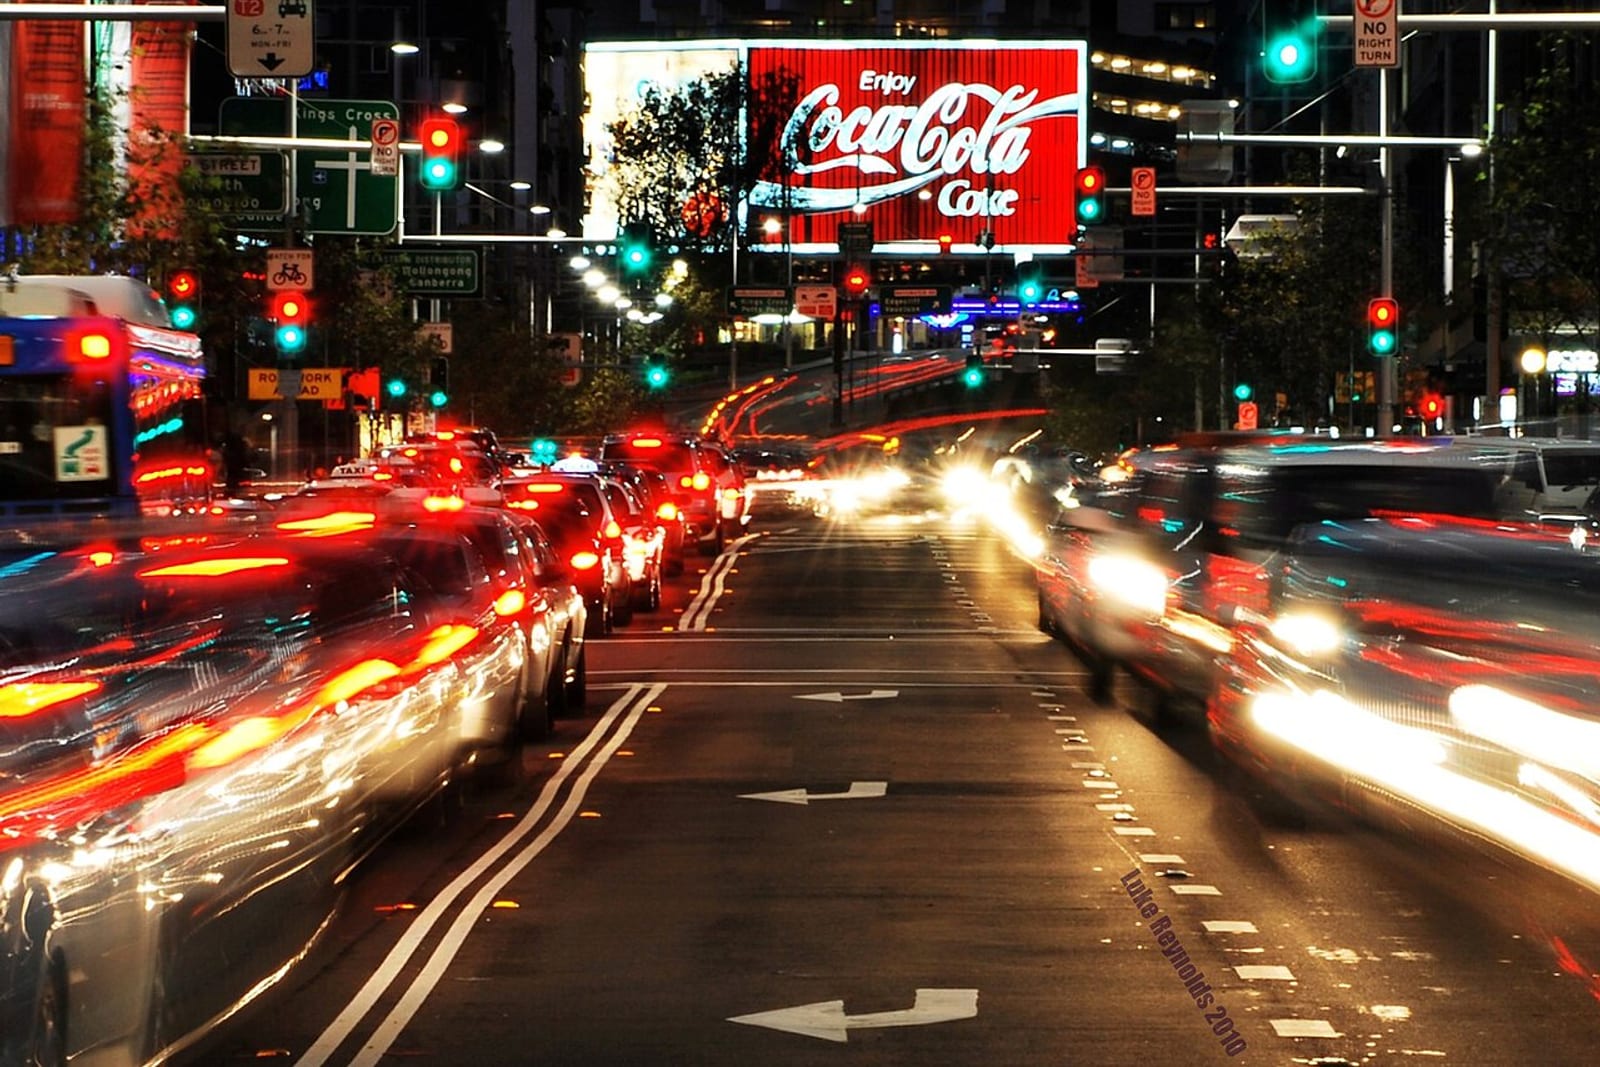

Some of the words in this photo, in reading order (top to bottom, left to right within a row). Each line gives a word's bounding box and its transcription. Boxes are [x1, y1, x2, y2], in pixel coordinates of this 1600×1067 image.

[239, 0, 260, 14] T2
[1364, 22, 1387, 35] NO
[1358, 39, 1392, 48] RIGHT
[1361, 51, 1391, 61] TURN
[859, 70, 917, 96] Enjoy
[345, 108, 391, 121] Cross
[780, 82, 1039, 175] Coca-Cola
[376, 147, 392, 157] NO
[200, 159, 258, 171] STREET
[192, 179, 244, 191] Nth
[937, 179, 1019, 217] Coke
[1136, 191, 1150, 199] NO
[402, 266, 473, 278] Wollongong
[409, 278, 465, 288] Canberra
[339, 467, 366, 475] TAXI
